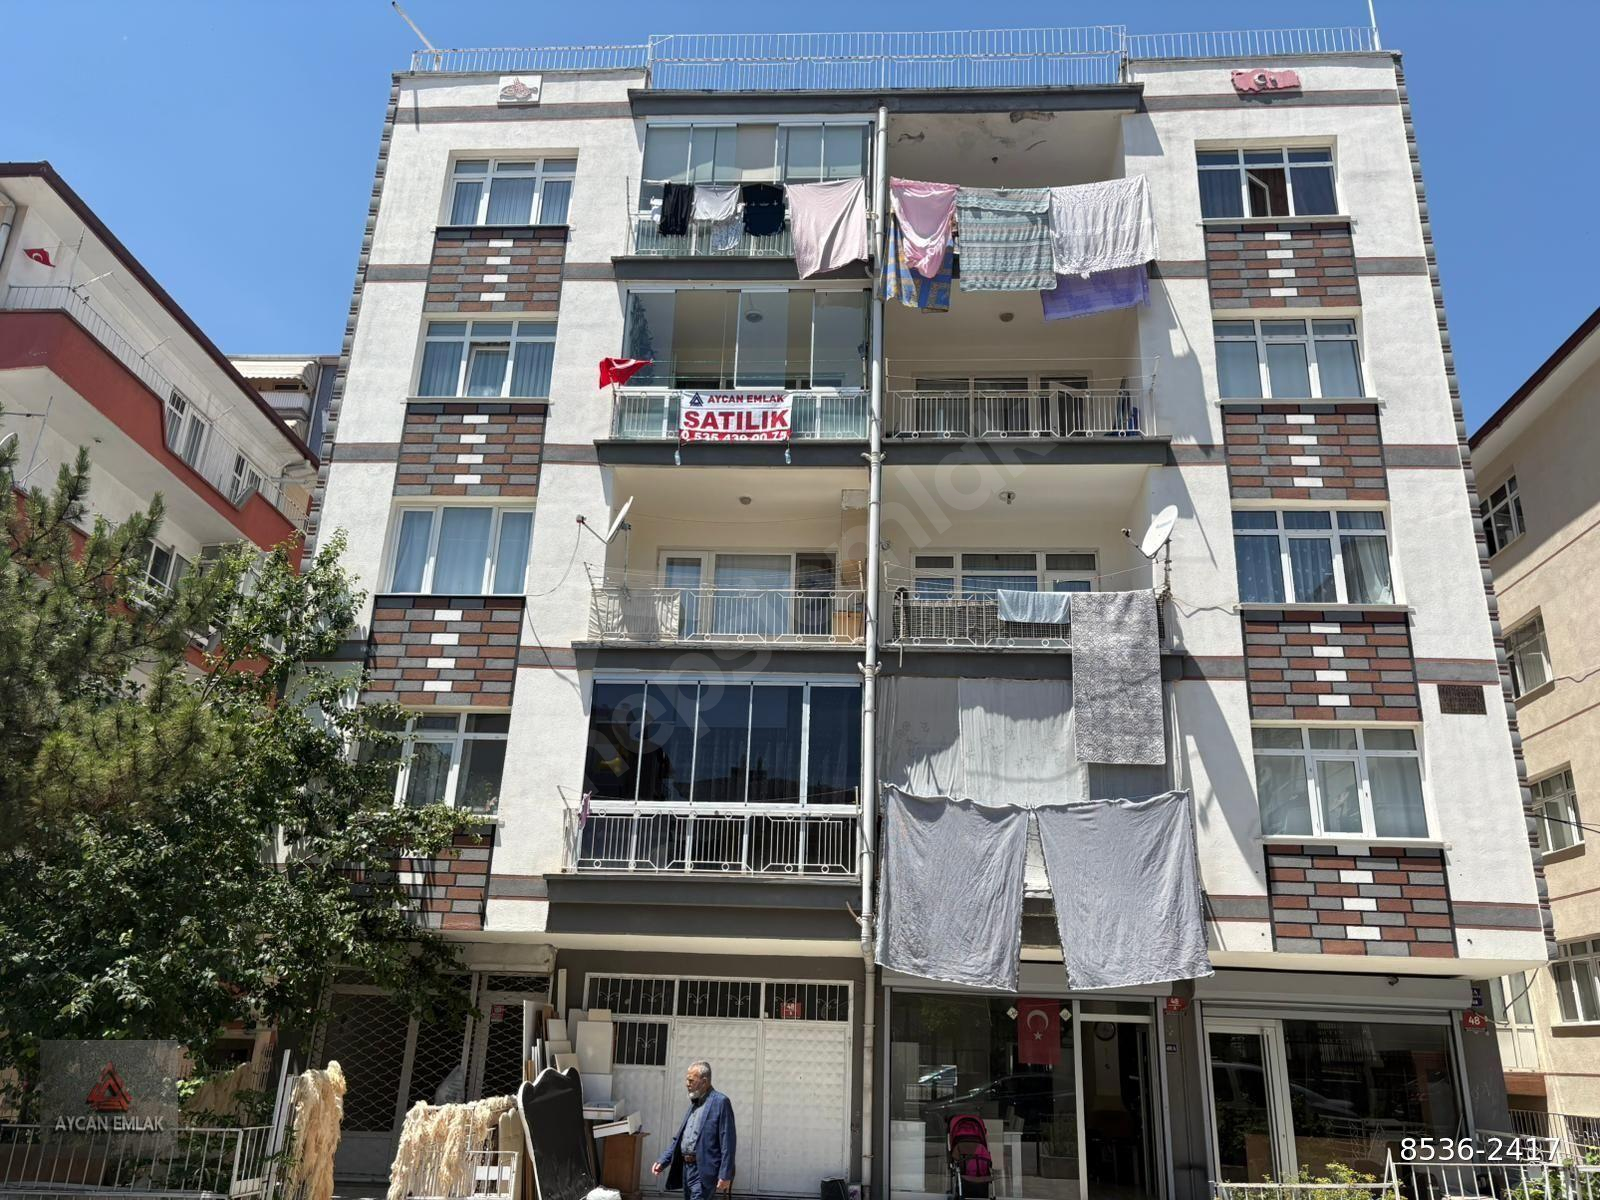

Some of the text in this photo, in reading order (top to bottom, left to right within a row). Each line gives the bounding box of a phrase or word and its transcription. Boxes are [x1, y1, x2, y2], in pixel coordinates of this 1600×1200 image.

[708, 395, 784, 403] AYCAN EMLAK
[684, 410, 789, 430] SATILIK
[1468, 1016, 1481, 1025] 48
